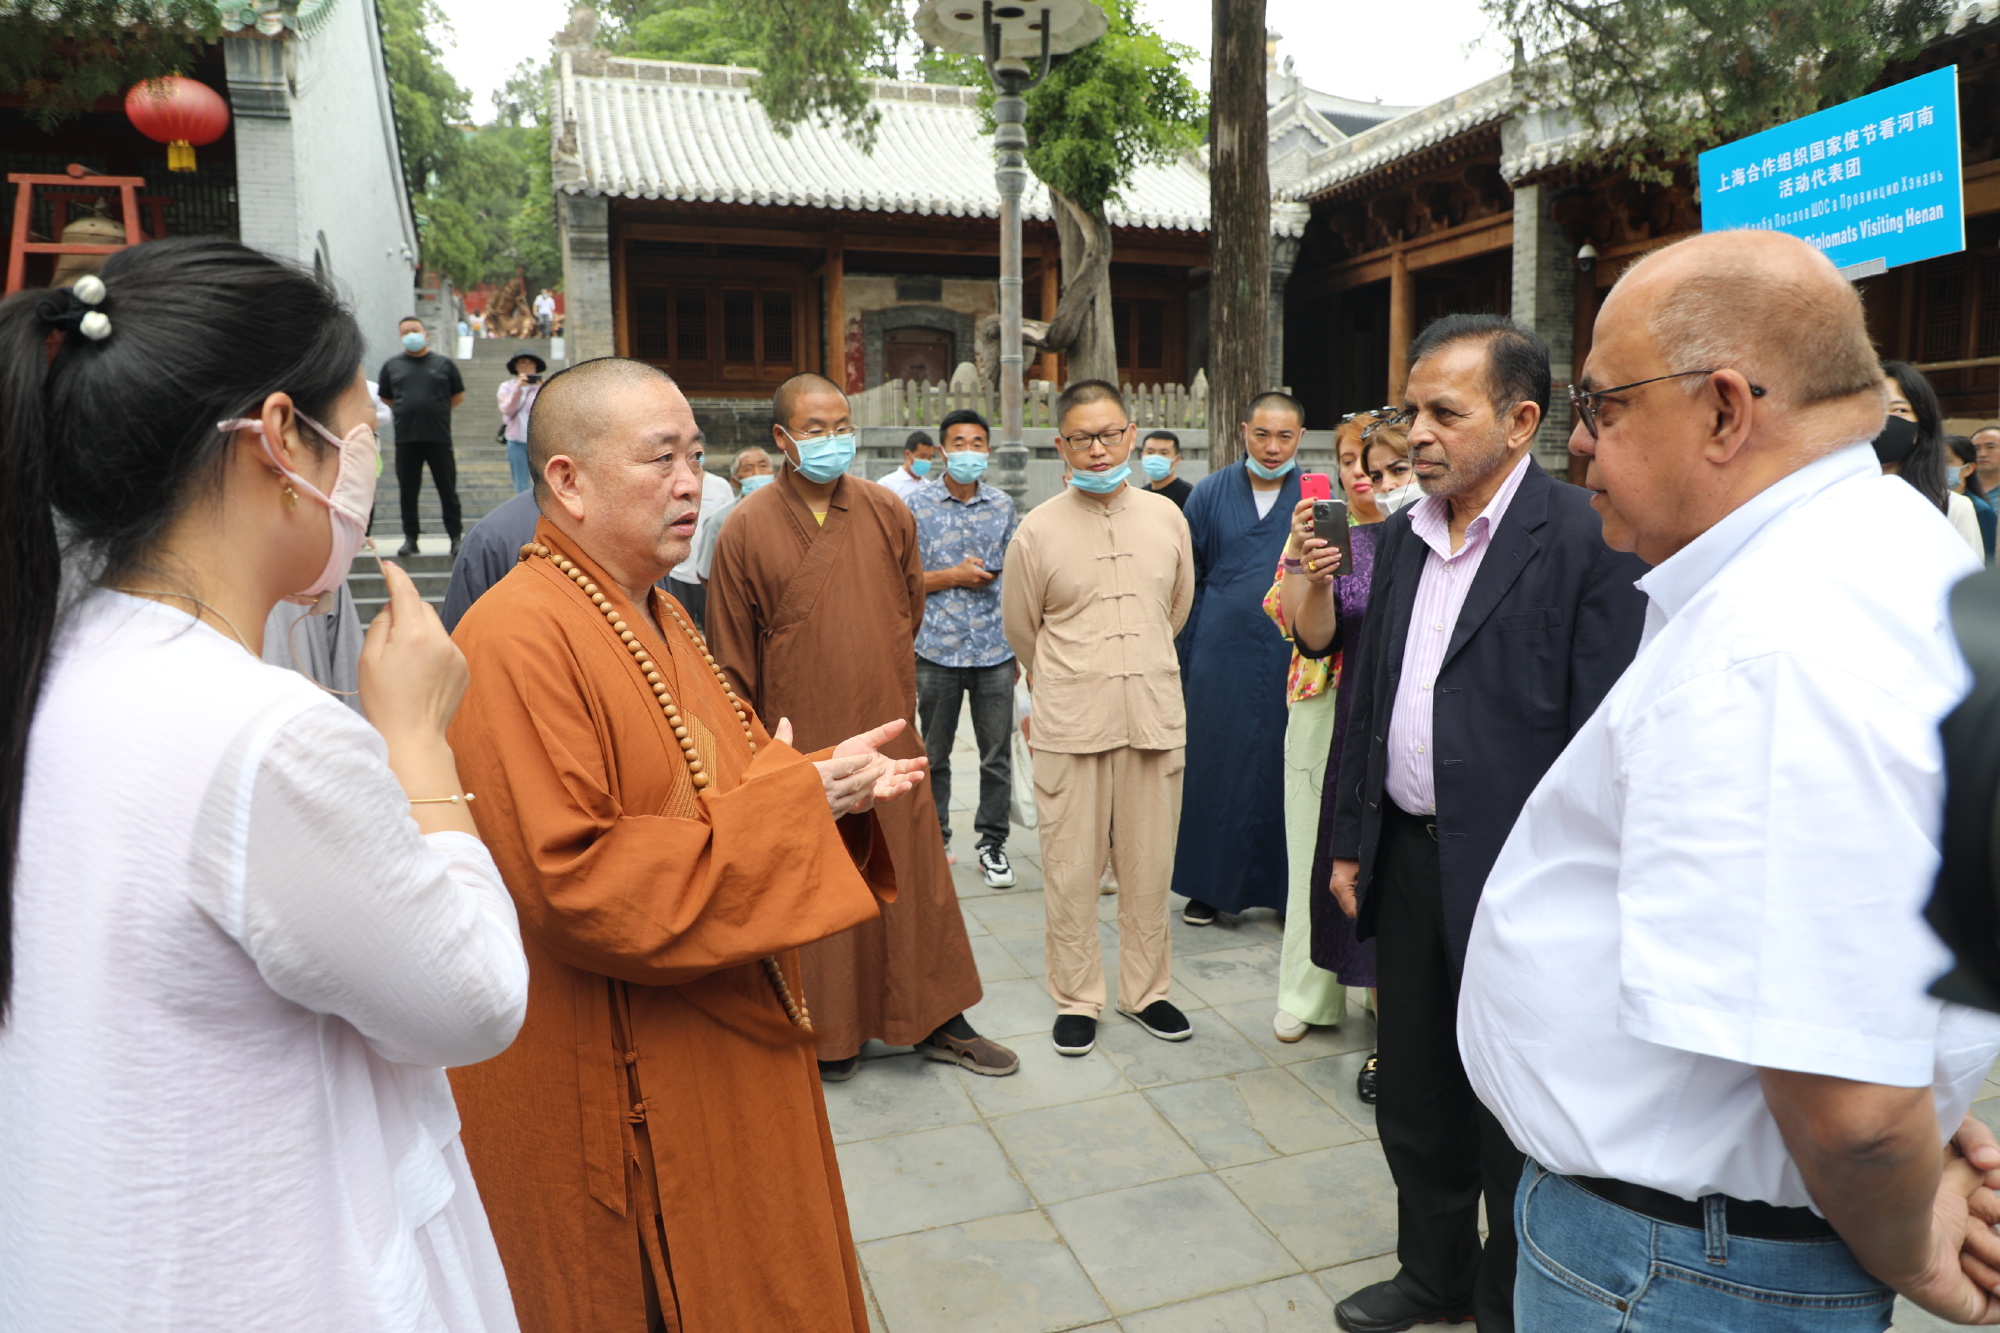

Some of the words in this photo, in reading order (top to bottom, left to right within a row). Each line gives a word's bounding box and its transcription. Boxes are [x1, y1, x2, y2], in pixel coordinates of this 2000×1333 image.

[1716, 105, 1935, 193] 上海合作组织国家使节看河南
[1774, 207, 1810, 228] Послов
[1810, 198, 1830, 218] ШОС
[1832, 199, 1838, 212] в
[1839, 180, 1900, 211] Провинцию
[1901, 170, 1943, 192] Хэнань
[1778, 157, 1861, 199] 活动代表团
[1859, 213, 1904, 240] Visiting
[1905, 204, 1944, 228] Henan
